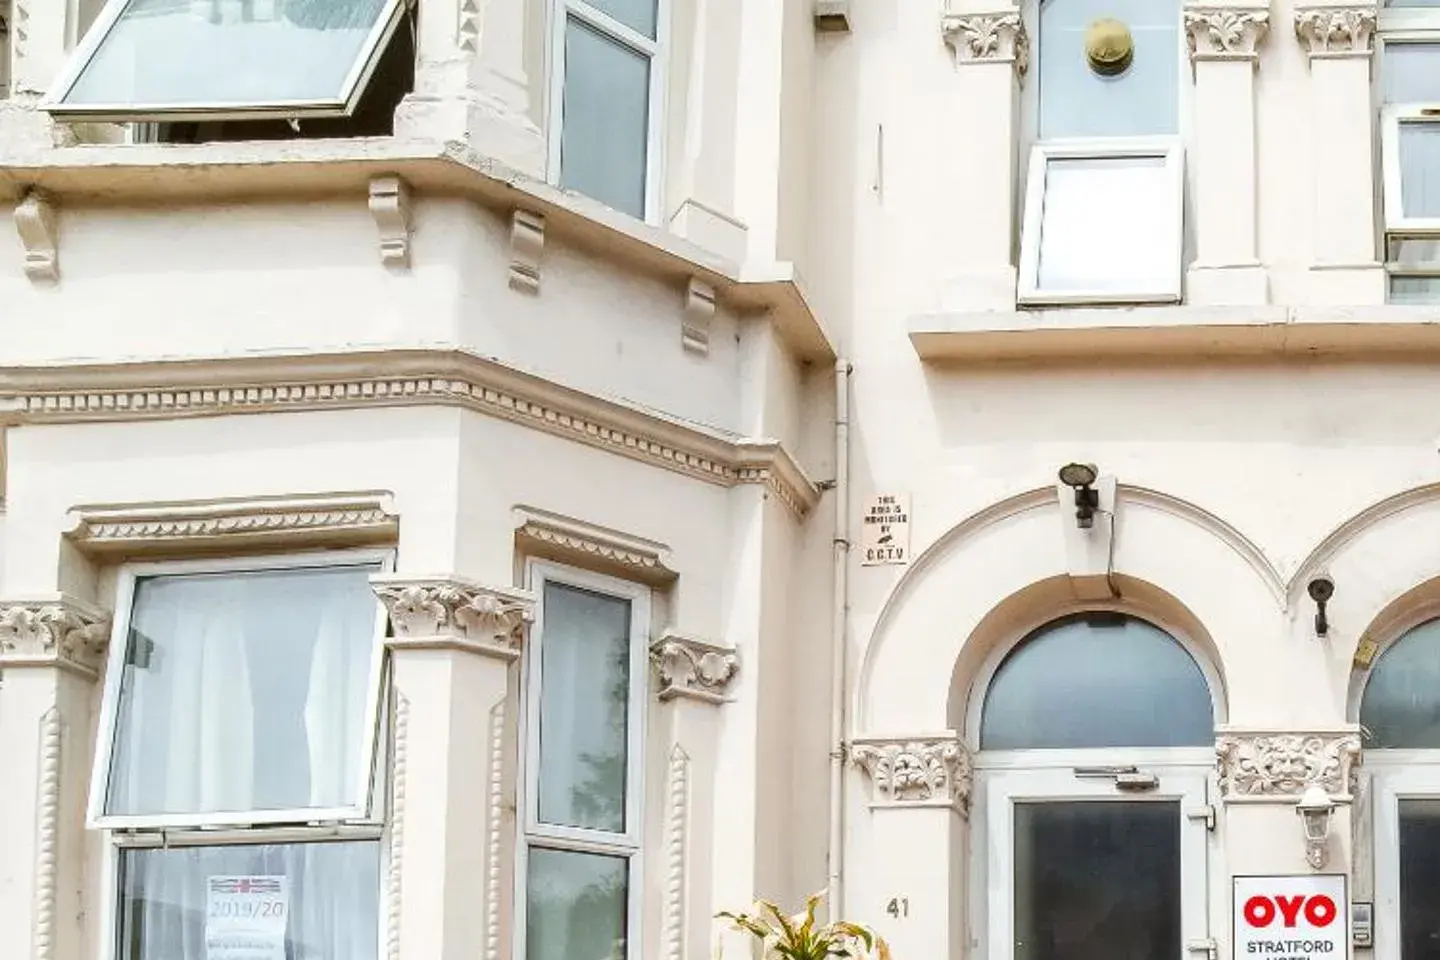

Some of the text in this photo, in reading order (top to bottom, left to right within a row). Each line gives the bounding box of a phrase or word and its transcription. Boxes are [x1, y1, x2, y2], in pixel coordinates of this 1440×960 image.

[212, 901, 284, 918] 2019/20
[887, 898, 909, 918] 41
[1244, 895, 1337, 928] OYO
[1247, 940, 1334, 953] STRATFORD
